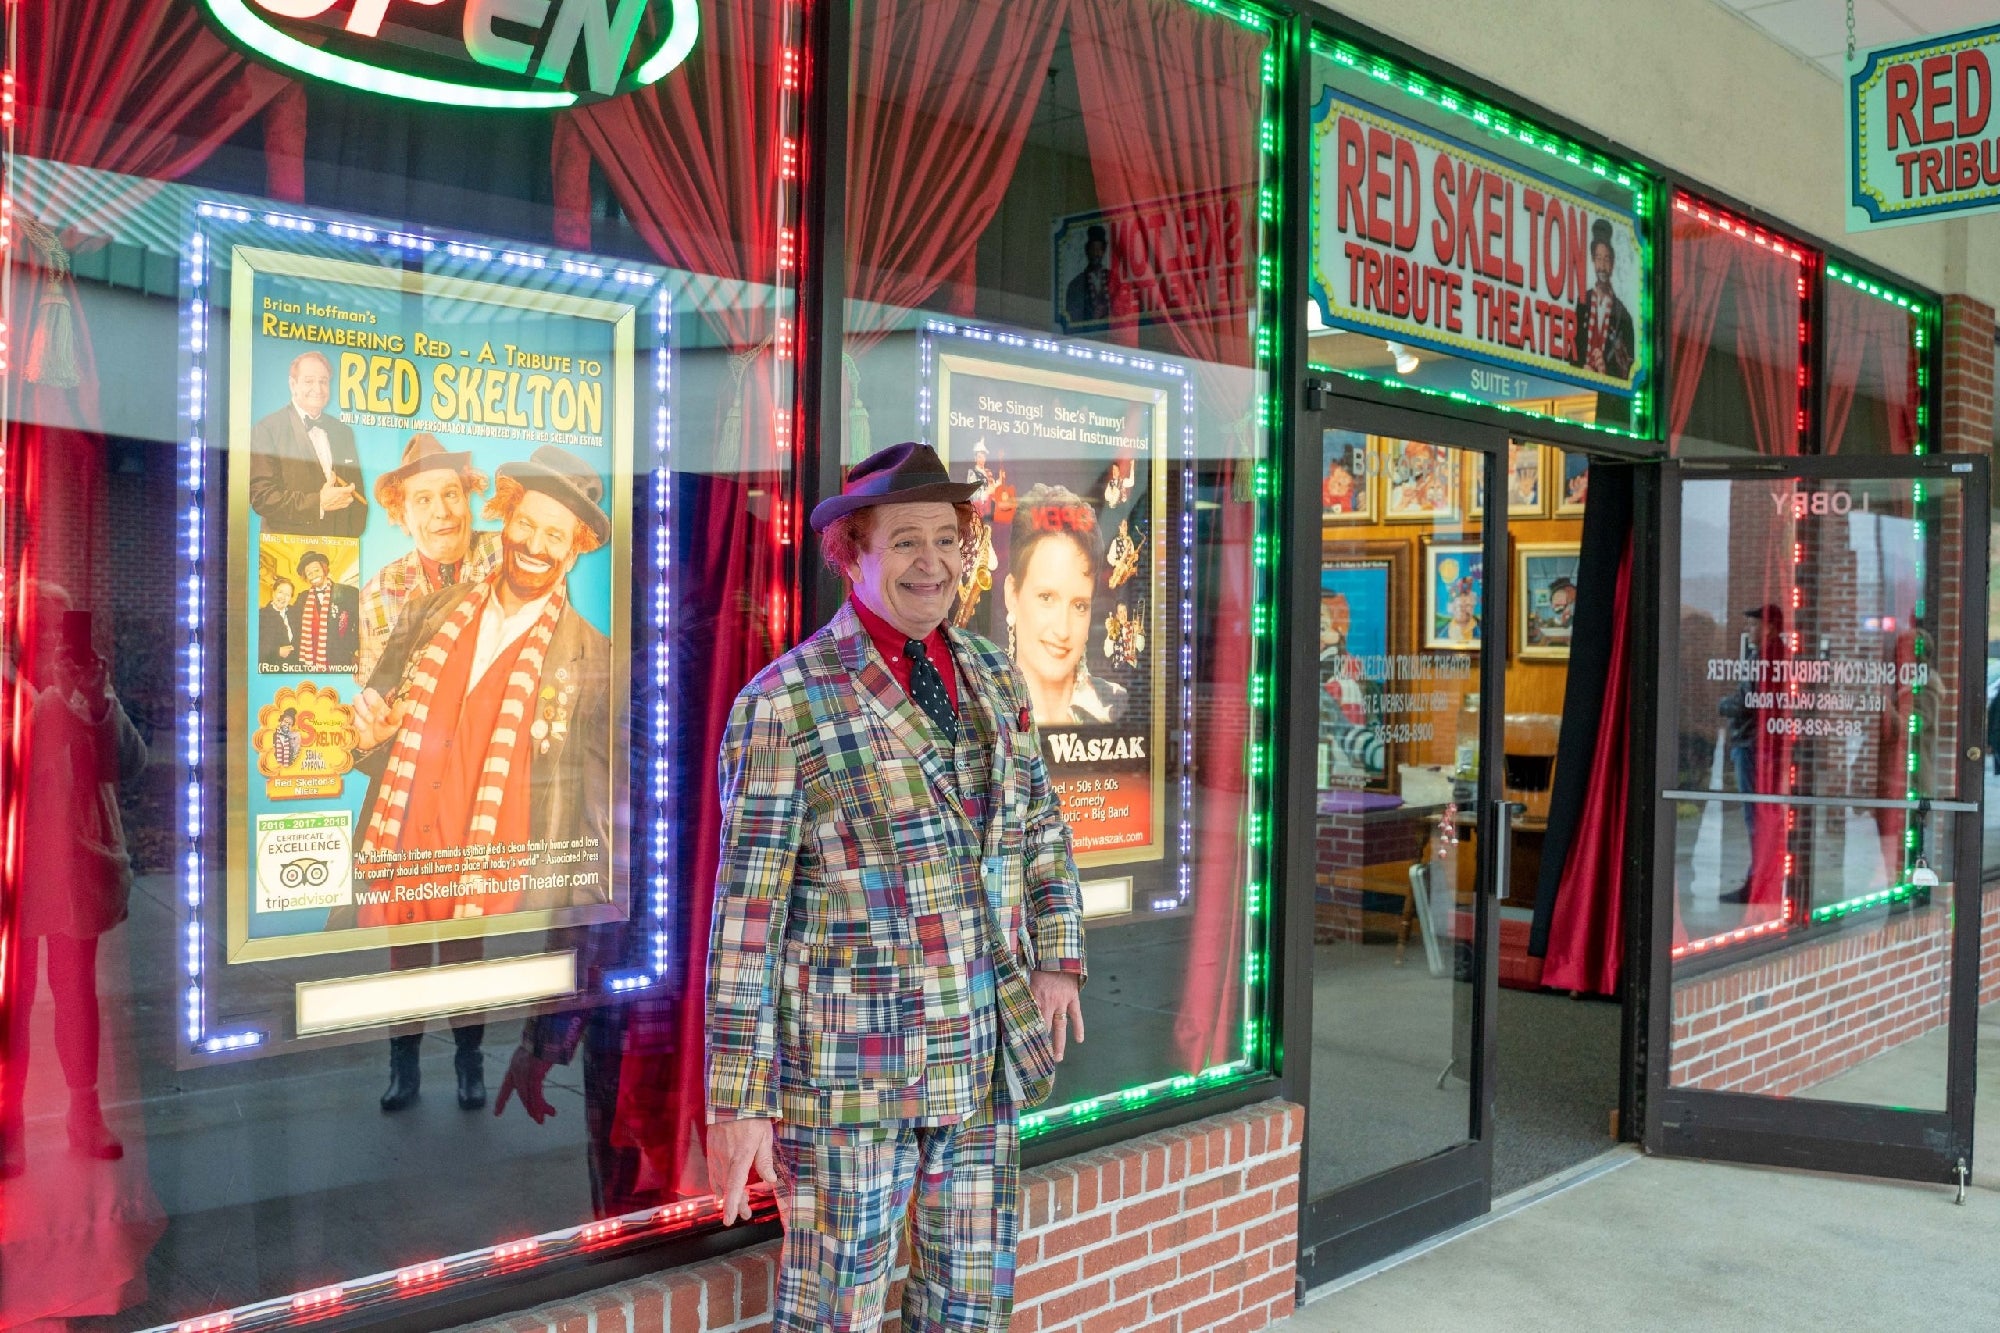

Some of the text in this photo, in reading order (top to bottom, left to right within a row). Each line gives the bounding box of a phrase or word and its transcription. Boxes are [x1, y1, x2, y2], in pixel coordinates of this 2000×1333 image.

[250, 0, 650, 96] EN
[1886, 48, 1992, 150] RED
[1896, 137, 2000, 198] TRIBU
[1337, 115, 1587, 304] RED SKELTON
[263, 297, 377, 324] Brian Hoffman's
[1344, 240, 1463, 334] TRIBUTE
[1472, 279, 1579, 363] THEATER
[262, 312, 405, 352] REMEMBERING
[414, 332, 451, 359] RED
[478, 342, 497, 364] A
[505, 344, 572, 374] TRIBUTE
[578, 360, 602, 377] TO
[339, 352, 603, 434] RED SKELTON
[1470, 369, 1529, 398] SUITE 17
[340, 412, 360, 425] ONLY
[362, 414, 376, 426] RED
[378, 415, 409, 429] SKELTON
[522, 429, 535, 441] THE
[580, 435, 604, 447] ESTATE
[978, 396, 1126, 433] She Sings! She's Funny!
[950, 411, 1149, 450] She Plays 30 Musical Instruments!
[258, 663, 280, 674] (RED
[1048, 733, 1146, 763] WASZAK
[274, 777, 335, 787] Red Skelton's
[1076, 780, 1092, 792] 50s
[1095, 779, 1102, 790] &
[1104, 778, 1119, 790] 60s
[1069, 794, 1105, 808] Comedy
[1092, 808, 1106, 822] Big
[1109, 806, 1129, 818] Band
[261, 821, 285, 830] 2016
[293, 819, 316, 829] 2017
[324, 817, 346, 826] 2018
[276, 832, 325, 843] CERTIFICATE
[268, 840, 341, 855] EXCELLENCE
[409, 848, 433, 860] tribute
[434, 846, 462, 858] reminds
[507, 841, 526, 853] clean
[527, 839, 548, 853] family
[549, 838, 570, 850] humor
[571, 836, 584, 848] and
[585, 836, 599, 847] love
[354, 867, 366, 880] for
[367, 867, 395, 880] country
[396, 863, 419, 877] should
[421, 862, 434, 875] still
[435, 862, 453, 874] have
[454, 863, 460, 871] a
[461, 859, 481, 874] place
[482, 858, 489, 869] in
[490, 857, 516, 870] today's
[546, 851, 581, 864] Associated
[582, 850, 599, 862] Press
[266, 893, 339, 911] tripadvisor
[355, 872, 599, 906] www.RedSkeltonTributeTheater.com
